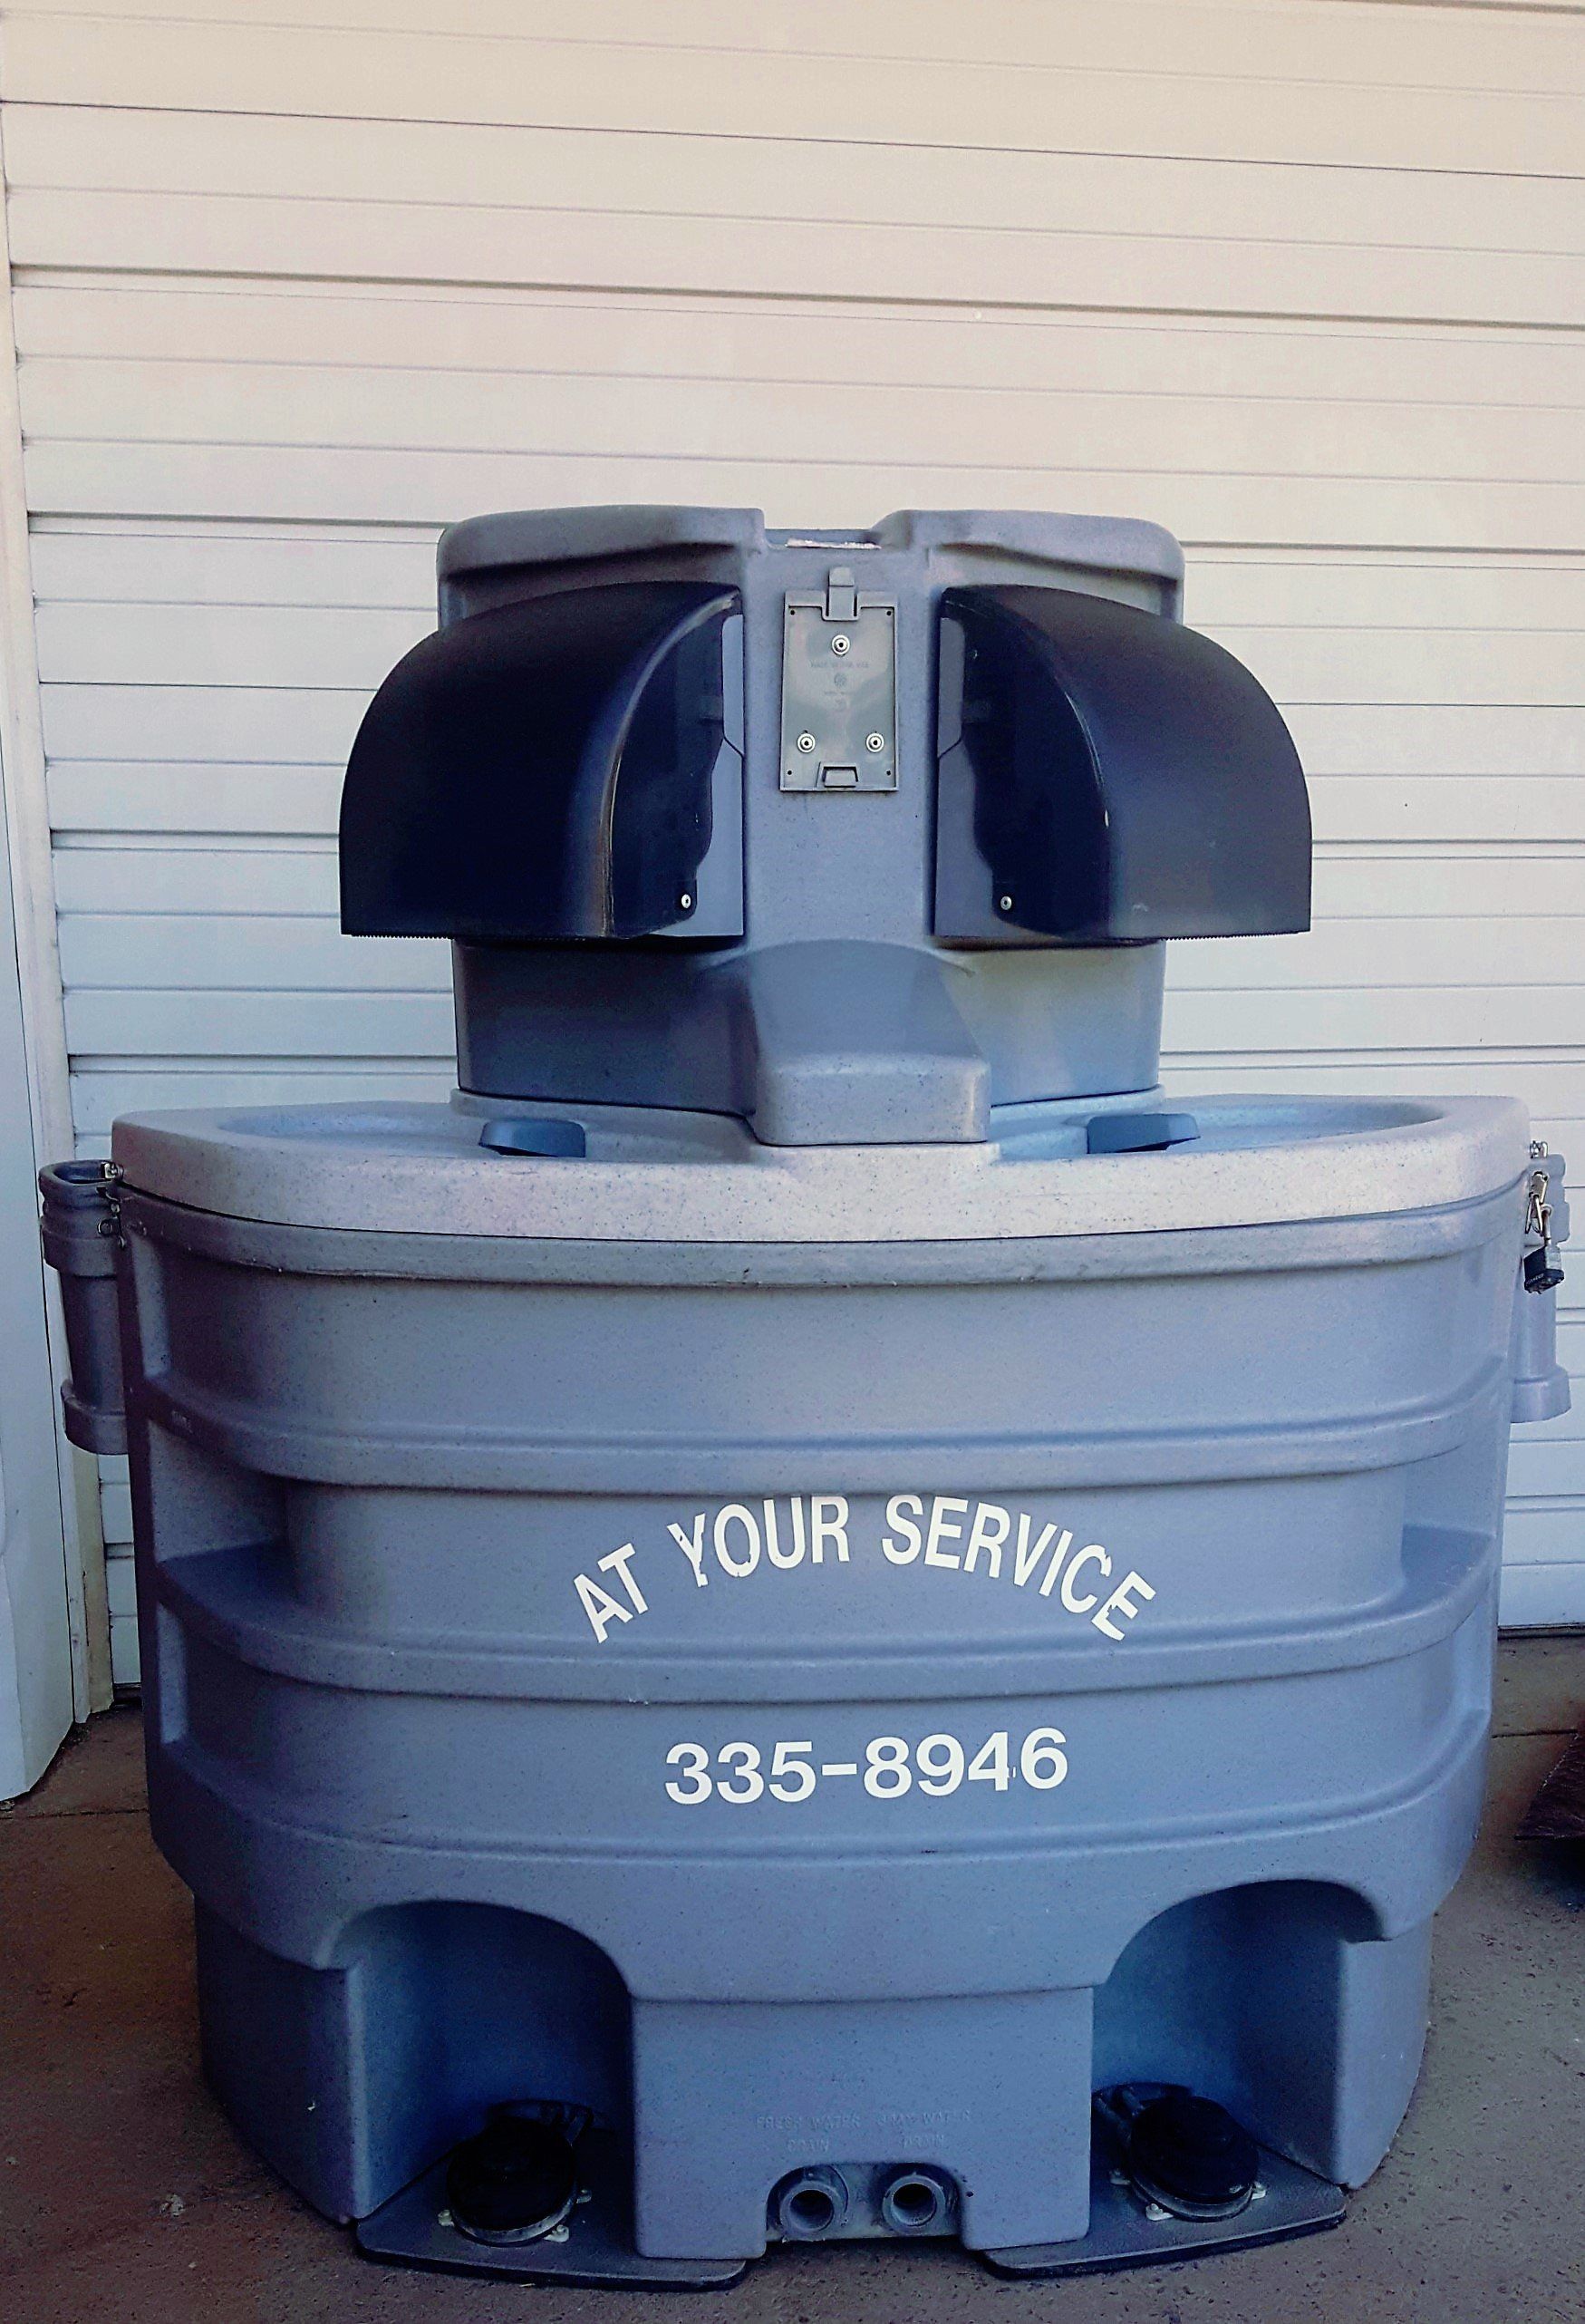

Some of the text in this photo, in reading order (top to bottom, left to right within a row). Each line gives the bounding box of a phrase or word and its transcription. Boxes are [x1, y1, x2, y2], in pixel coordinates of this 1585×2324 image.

[574, 1495, 1156, 1643] AT YOUR SERVICE
[665, 1728, 1068, 1805] 335-8946
